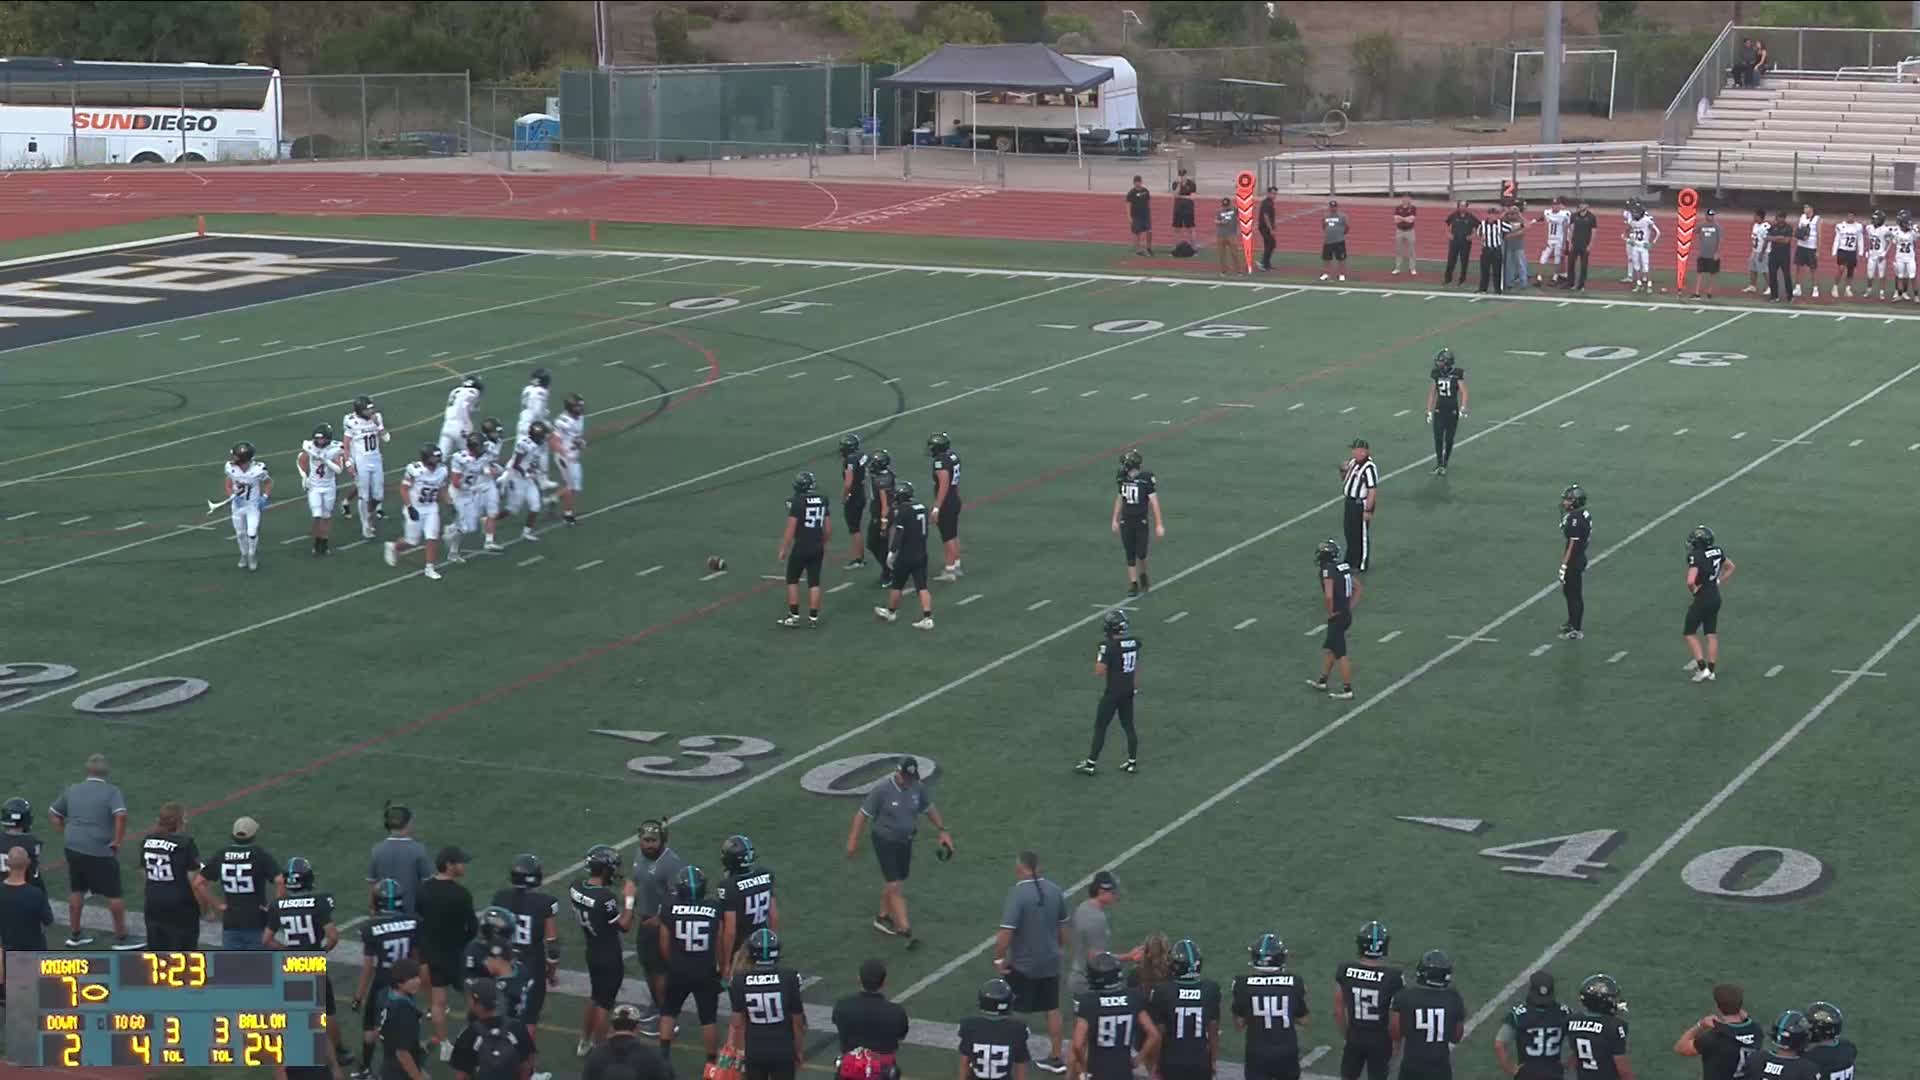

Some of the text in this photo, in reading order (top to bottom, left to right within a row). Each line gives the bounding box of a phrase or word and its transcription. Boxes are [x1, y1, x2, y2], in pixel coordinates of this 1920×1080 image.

[1438, 380, 1451, 397] 21
[363, 434, 377, 451] 10
[315, 463, 326, 478] 4
[1121, 484, 1139, 504] 40
[805, 506, 825, 528] 54
[916, 513, 926, 535] 7
[1122, 651, 1137, 673] 10
[144, 852, 174, 881] 56
[221, 863, 255, 893] 55
[736, 873, 771, 891] STEWART
[278, 897, 315, 909] VASQUEZ
[744, 890, 770, 925] 42
[280, 914, 316, 946] 24
[675, 920, 710, 952] 45
[383, 937, 410, 968] 31
[745, 974, 780, 985] GARCIA
[1346, 967, 1384, 982] STEHLY
[744, 991, 784, 1024] 20
[1179, 988, 1201, 1000] RIZO
[1351, 986, 1380, 1021] 12
[1174, 1006, 1203, 1039] 17
[1251, 995, 1290, 1029] 44
[1415, 1008, 1445, 1042] 41
[1097, 1014, 1133, 1047] 87
[1568, 1020, 1603, 1034] VALLEJO
[1525, 1027, 1562, 1057] 32
[1576, 1037, 1599, 1071] 9
[972, 1043, 1010, 1079] 32
[1763, 1061, 1784, 1076] BUI
